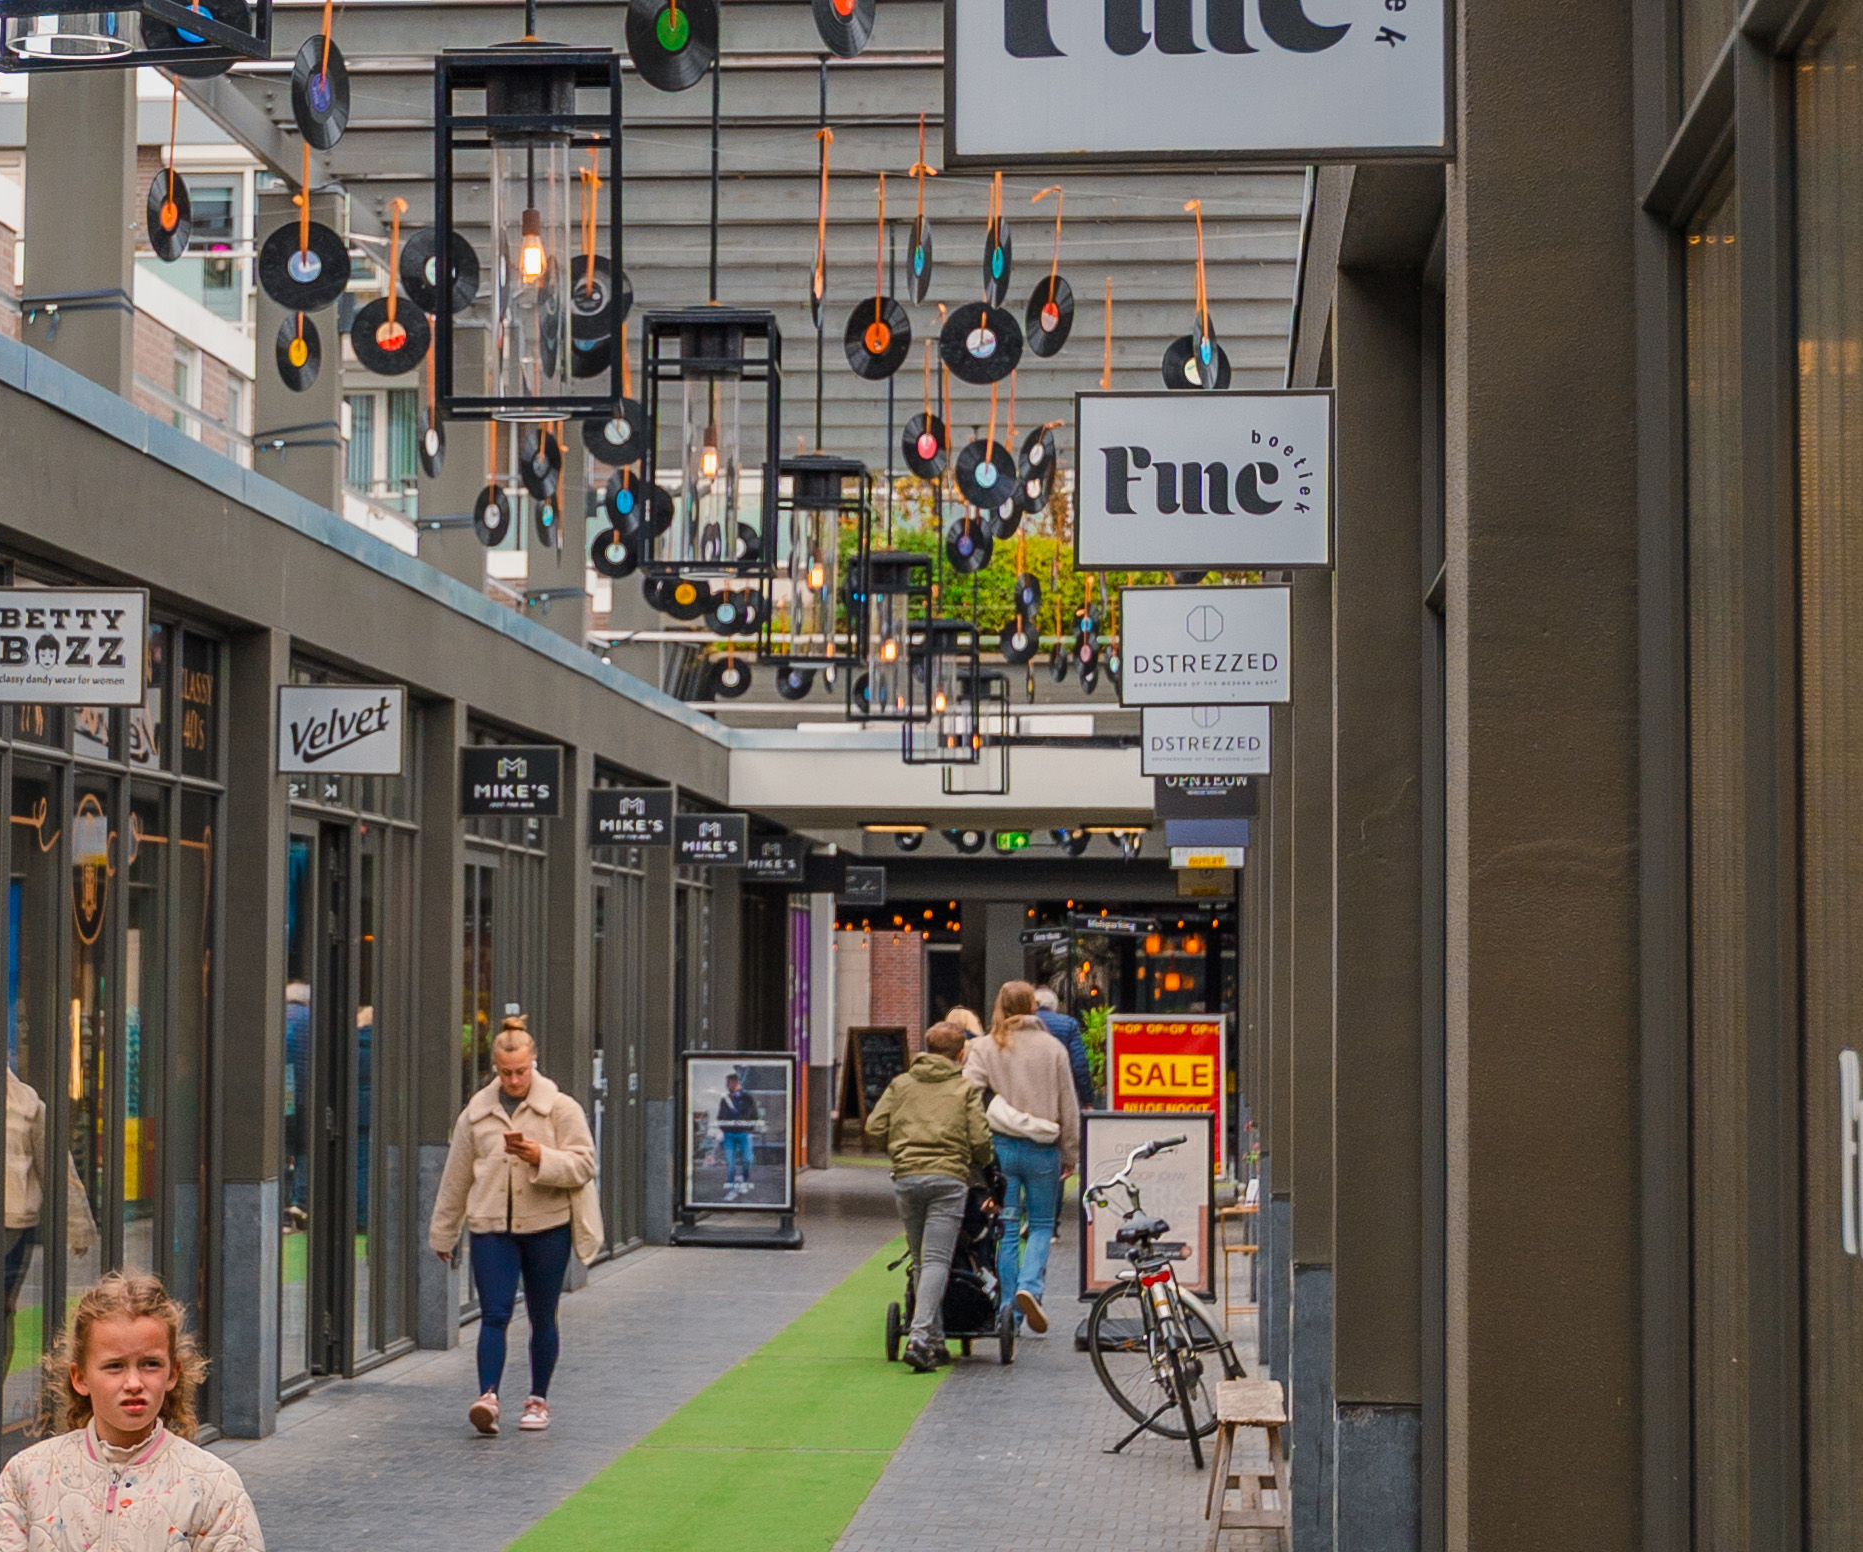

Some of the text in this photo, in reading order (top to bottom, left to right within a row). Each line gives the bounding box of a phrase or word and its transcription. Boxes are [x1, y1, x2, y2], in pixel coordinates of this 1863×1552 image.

[1098, 446, 1283, 516] Func
[1251, 430, 1313, 515] boetiek
[0, 607, 125, 630] BETTY
[0, 630, 126, 670] BZZ
[1134, 653, 1278, 674] DSTREZZED
[26, 674, 53, 686] dandy
[55, 677, 76, 685] wear
[78, 674, 90, 685] for
[92, 677, 125, 686] women
[289, 696, 392, 758] Velvet
[1151, 736, 1261, 752] DSTREZZED
[473, 783, 550, 799] MIKE'S
[599, 819, 664, 833] MIKE'S
[681, 840, 738, 853] MIKE'S
[747, 859, 797, 870] MIKE'S
[1112, 1023, 1143, 1035] P=OP
[1124, 1062, 1209, 1087] SALE
